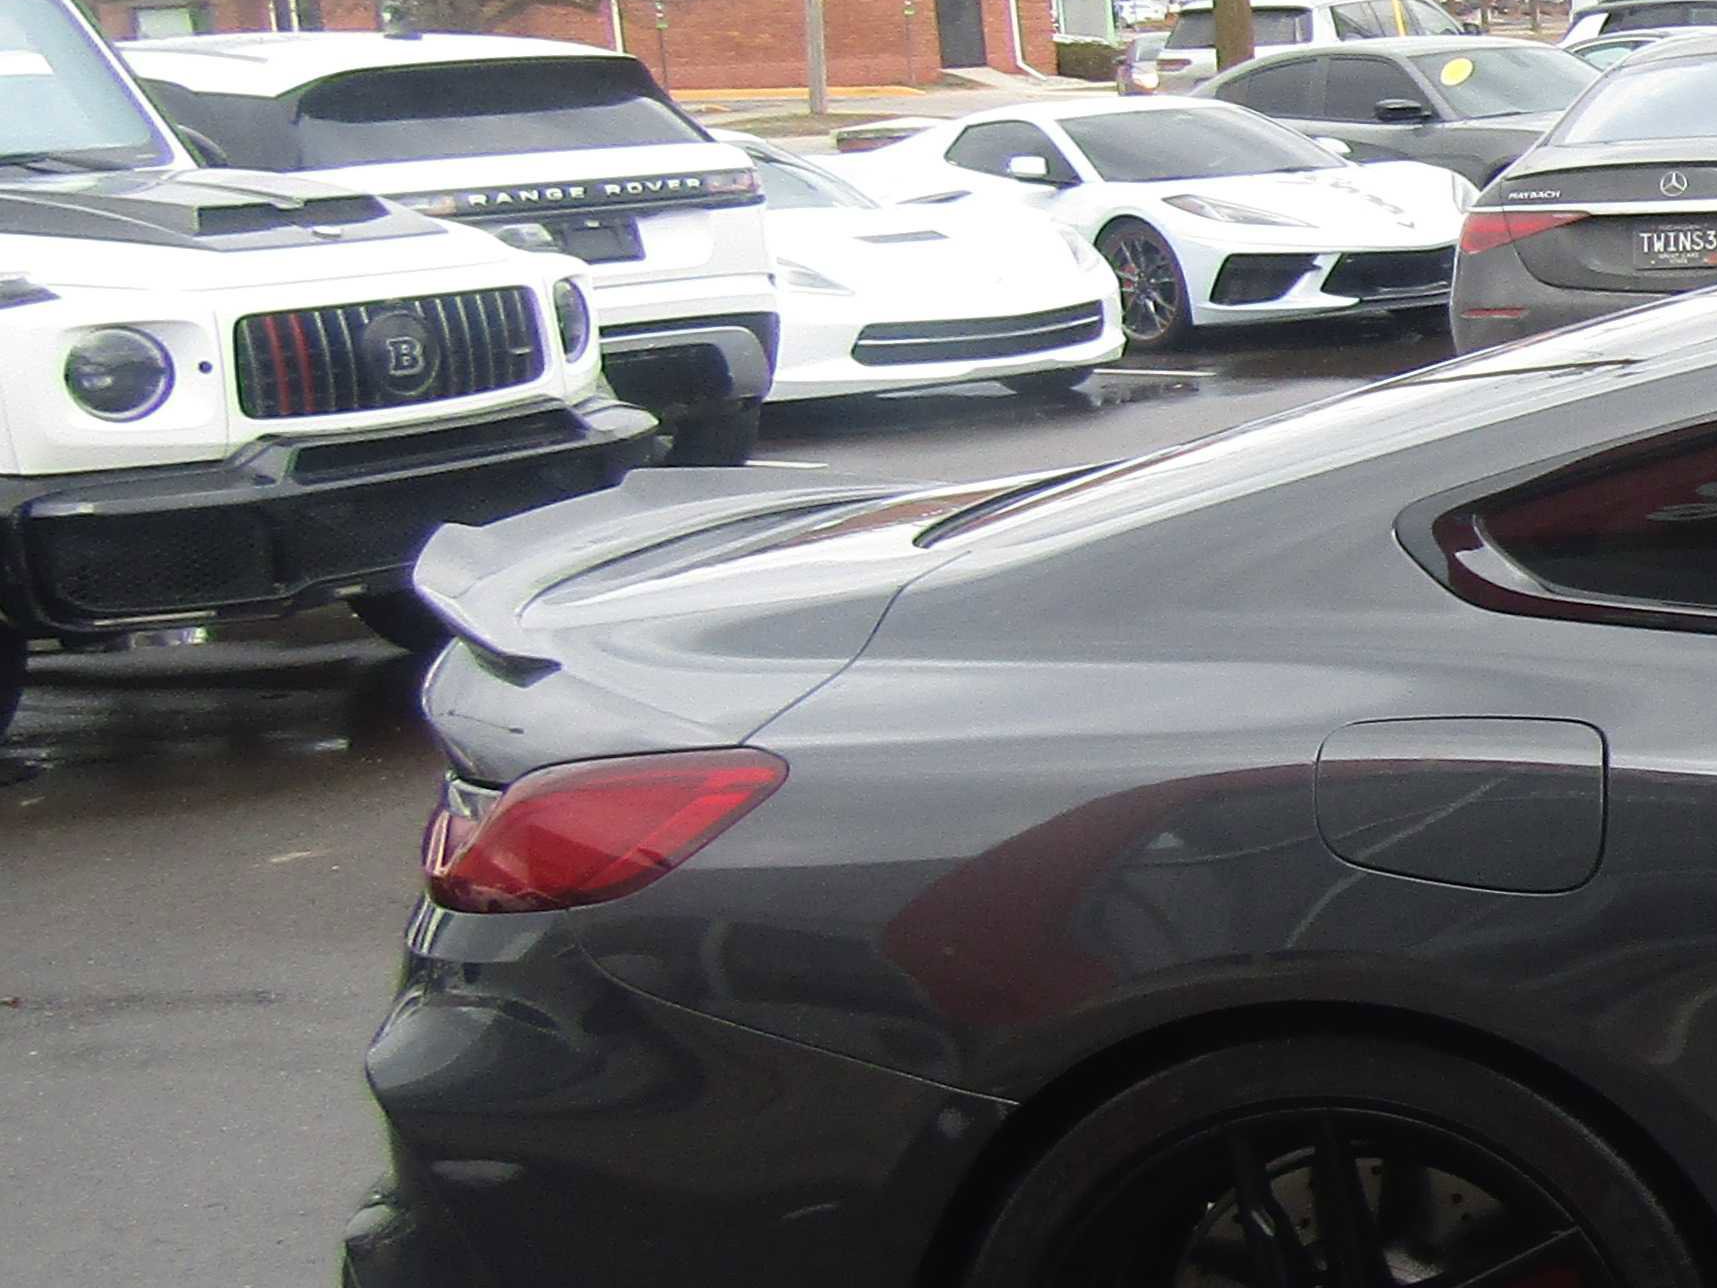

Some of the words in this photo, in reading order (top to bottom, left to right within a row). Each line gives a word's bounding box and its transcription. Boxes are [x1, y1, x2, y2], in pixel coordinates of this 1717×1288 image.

[468, 186, 586, 206] RANGE
[603, 177, 702, 196] ROVER
[1639, 230, 1717, 253] TWINS3
[386, 336, 425, 376] B
